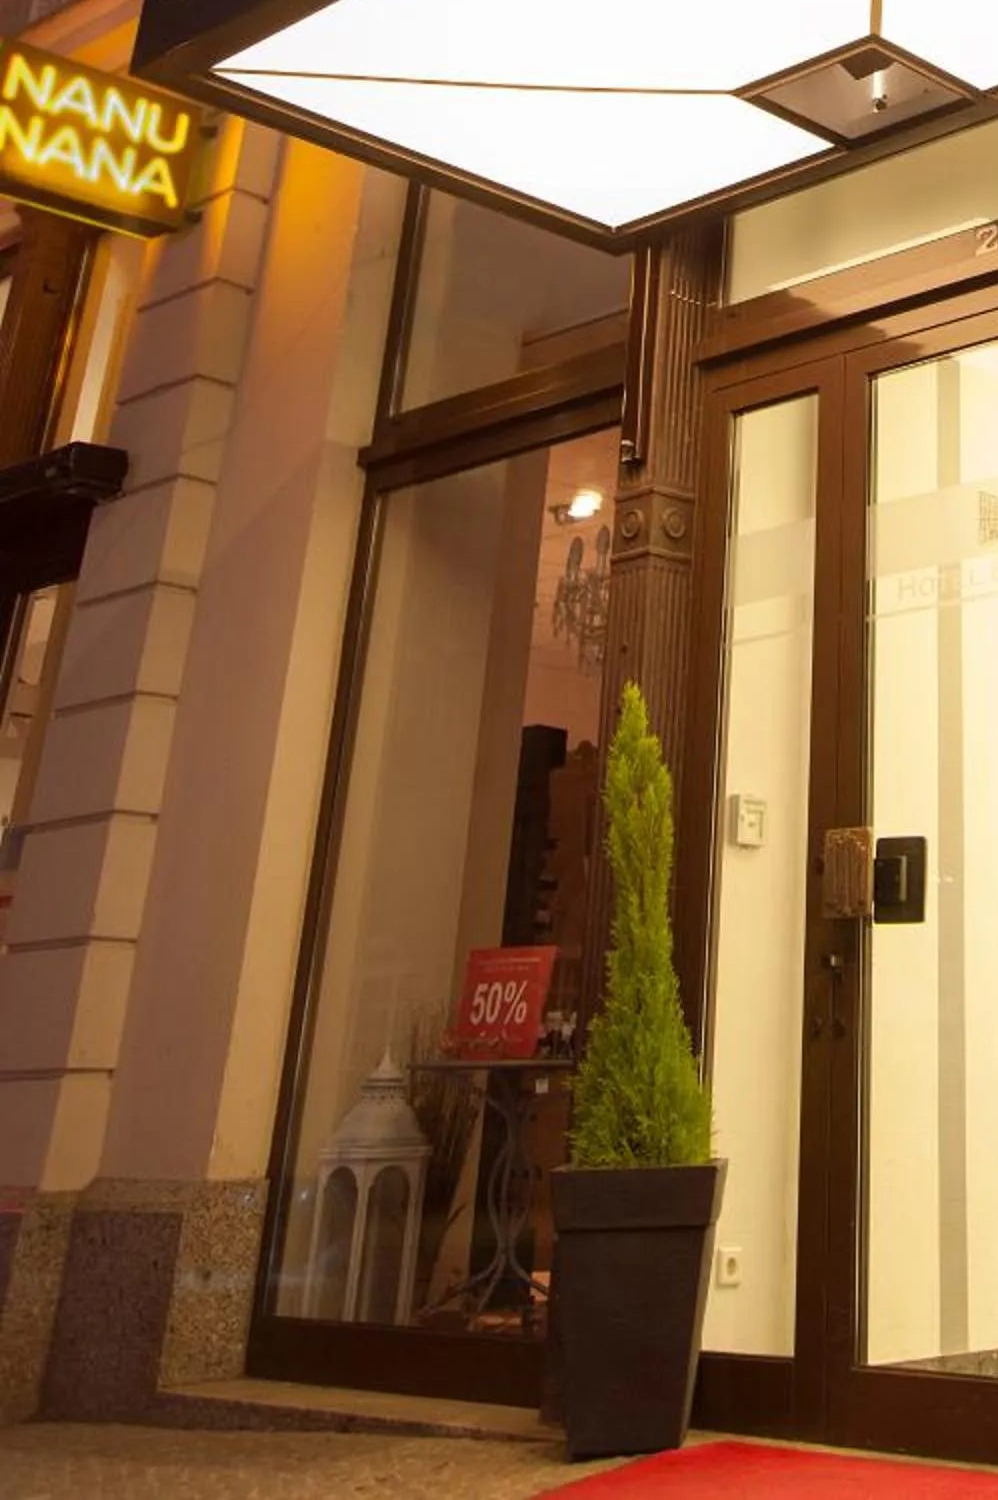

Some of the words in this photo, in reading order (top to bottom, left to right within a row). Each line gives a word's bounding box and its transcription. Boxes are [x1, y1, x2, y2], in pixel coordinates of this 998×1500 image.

[3, 53, 190, 154] NANU
[0, 105, 178, 208] NANA
[469, 979, 529, 1026] 50%
